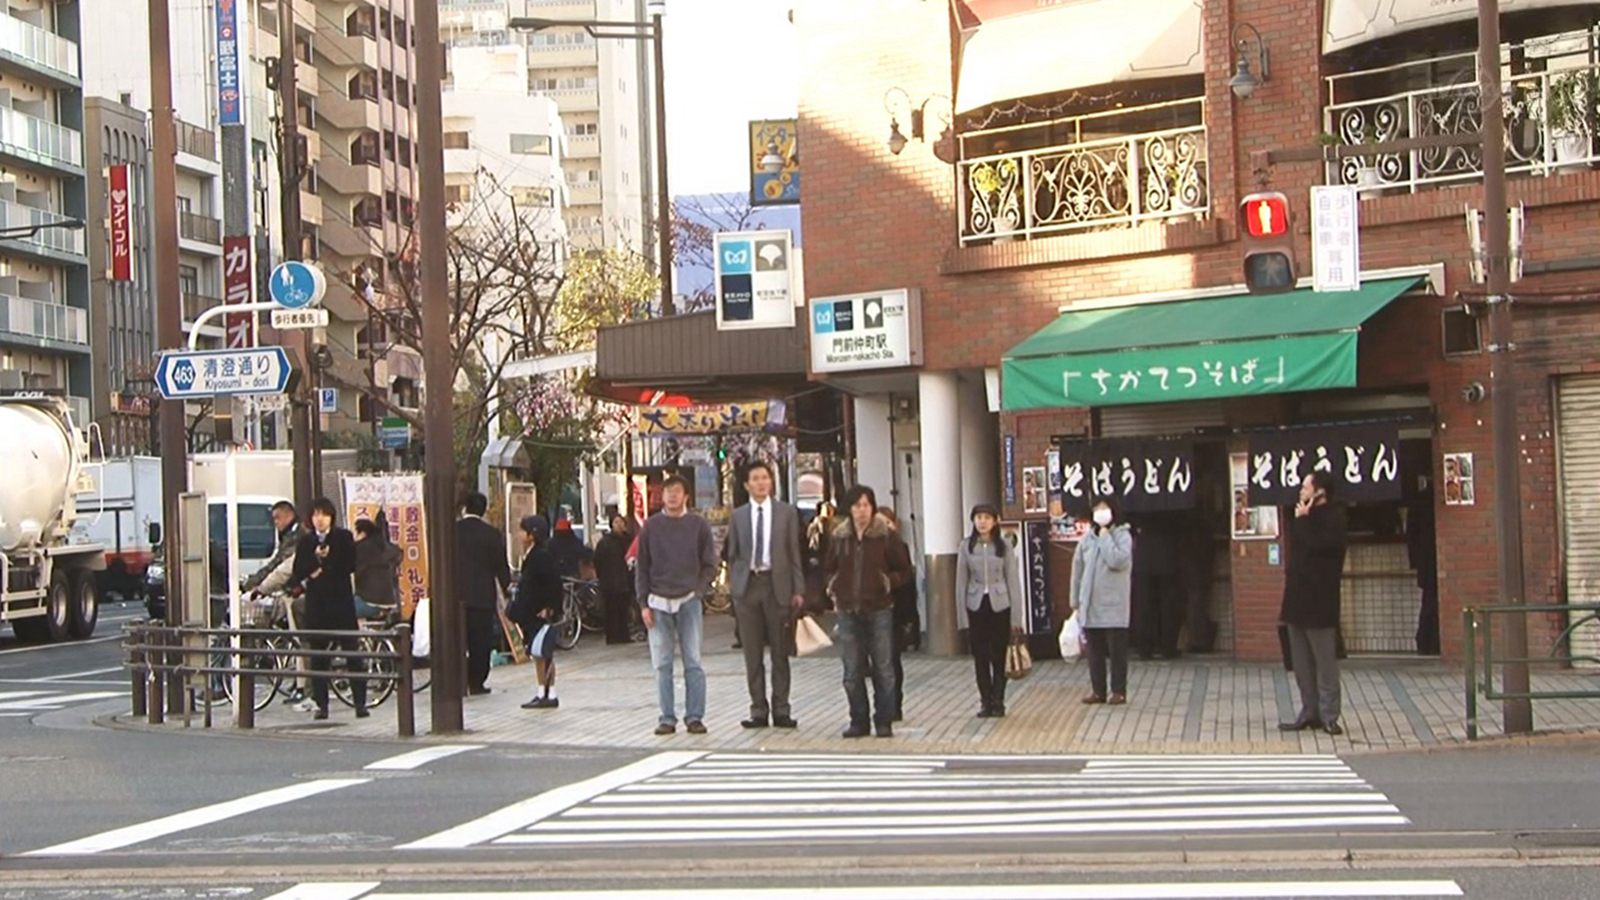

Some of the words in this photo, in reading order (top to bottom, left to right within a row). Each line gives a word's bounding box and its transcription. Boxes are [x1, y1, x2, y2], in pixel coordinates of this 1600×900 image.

[113, 204, 128, 257] アイフル
[274, 313, 315, 325] 歩行者優先
[832, 333, 888, 353] 門前仲町駅
[174, 366, 194, 385] 463
[203, 355, 271, 378] 清澄通り
[205, 377, 243, 391] Kiyosumi
[253, 375, 270, 387] dori
[1251, 443, 1398, 489] そばうどん
[1062, 457, 1191, 497] そばうどん
